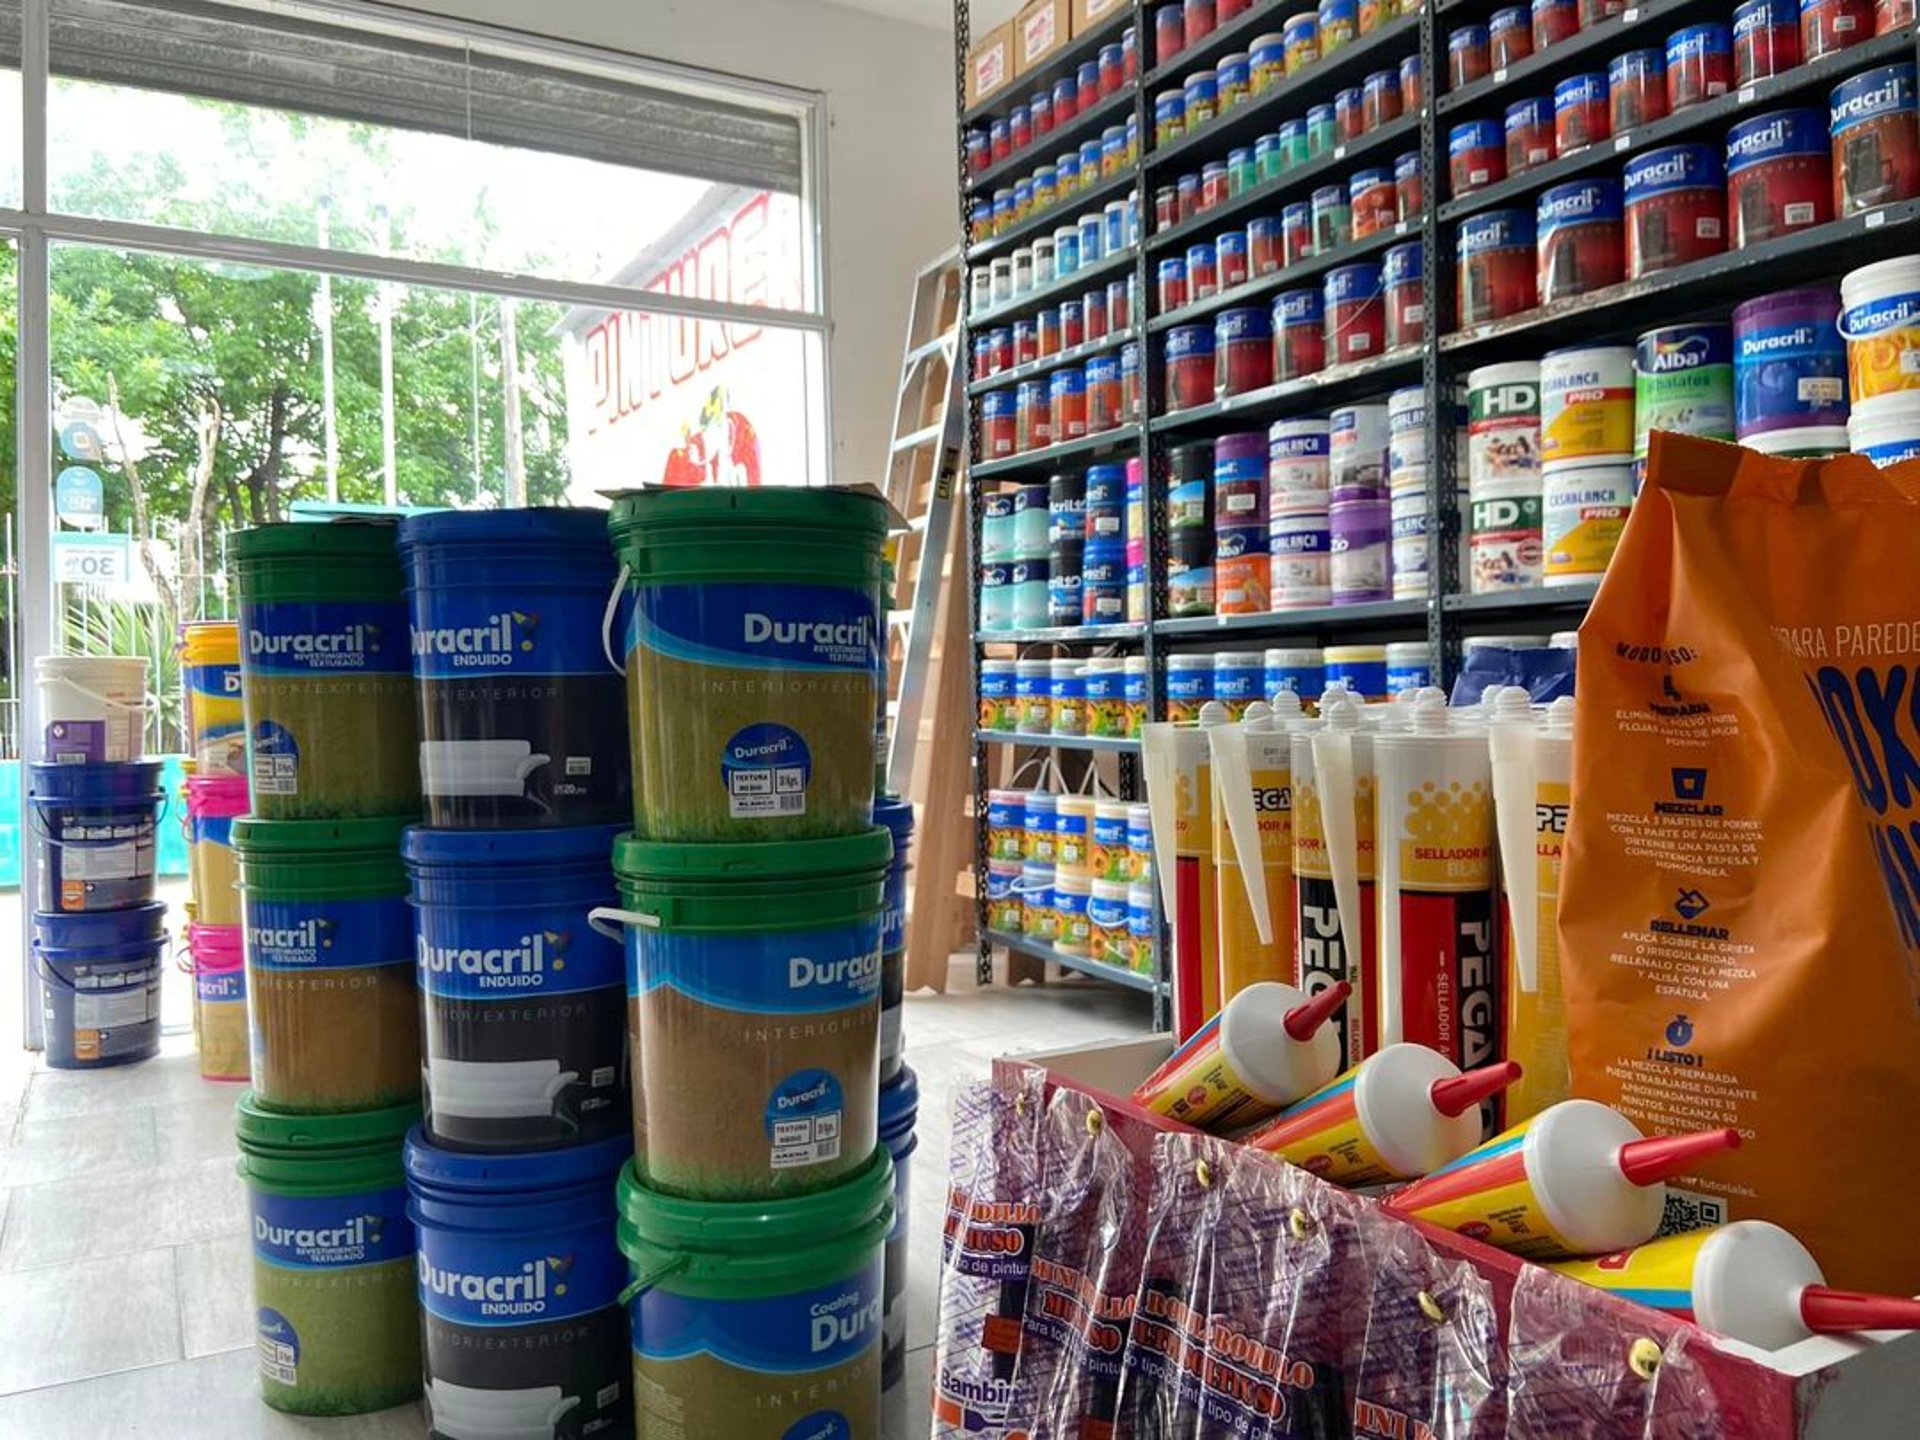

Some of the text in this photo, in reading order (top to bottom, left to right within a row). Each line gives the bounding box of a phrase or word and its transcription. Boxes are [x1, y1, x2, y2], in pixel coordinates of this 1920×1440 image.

[1743, 328, 1805, 355] Duracril
[1653, 351, 1701, 371] Alba
[1483, 384, 1537, 415] HD
[1568, 389, 1605, 403] PRO
[1473, 500, 1520, 530] HD
[1582, 507, 1621, 520] PRO
[249, 624, 365, 655] Duracril
[744, 612, 868, 646] Duracril
[453, 654, 512, 667] ENDUIDO
[734, 738, 787, 759] Duracril
[1643, 827, 1680, 838] PARTE
[1700, 830, 1730, 841] AGUA
[1414, 847, 1484, 861] SELLADOR
[1677, 842, 1702, 852] UNA
[1704, 843, 1739, 853] PASTA
[1706, 855, 1750, 866] ESPESA
[1650, 920, 1730, 941] RELLENAR
[417, 933, 543, 975] Duracril
[1661, 936, 1699, 950] SOBRE
[1701, 940, 1716, 951] LA
[1718, 942, 1755, 954] GRIETA
[479, 973, 543, 988] ENDUIDO
[1675, 962, 1699, 974] CON
[1702, 965, 1716, 977] LA
[1718, 967, 1757, 979] MEZCLA
[1682, 975, 1706, 988] CON
[1707, 979, 1730, 990] UNA
[1436, 971, 1451, 1043] SELLADOR
[1617, 1055, 1738, 1084] LA MEZCLA PREPARADA
[1606, 1065, 1758, 1101] PUEDE TRABAJARSE DURANTE
[777, 1081, 827, 1109] Duracril
[1621, 1082, 1723, 1109] APROXIMADAMENTE
[1668, 1103, 1720, 1122] ALCANZA
[1722, 1112, 1738, 1124] SU
[255, 1214, 365, 1248] Duracril
[418, 1249, 546, 1302] Duracril
[971, 1259, 988, 1273] de
[481, 1300, 546, 1315] ENDUIDO
[1207, 1399, 1249, 1434] tipo de
